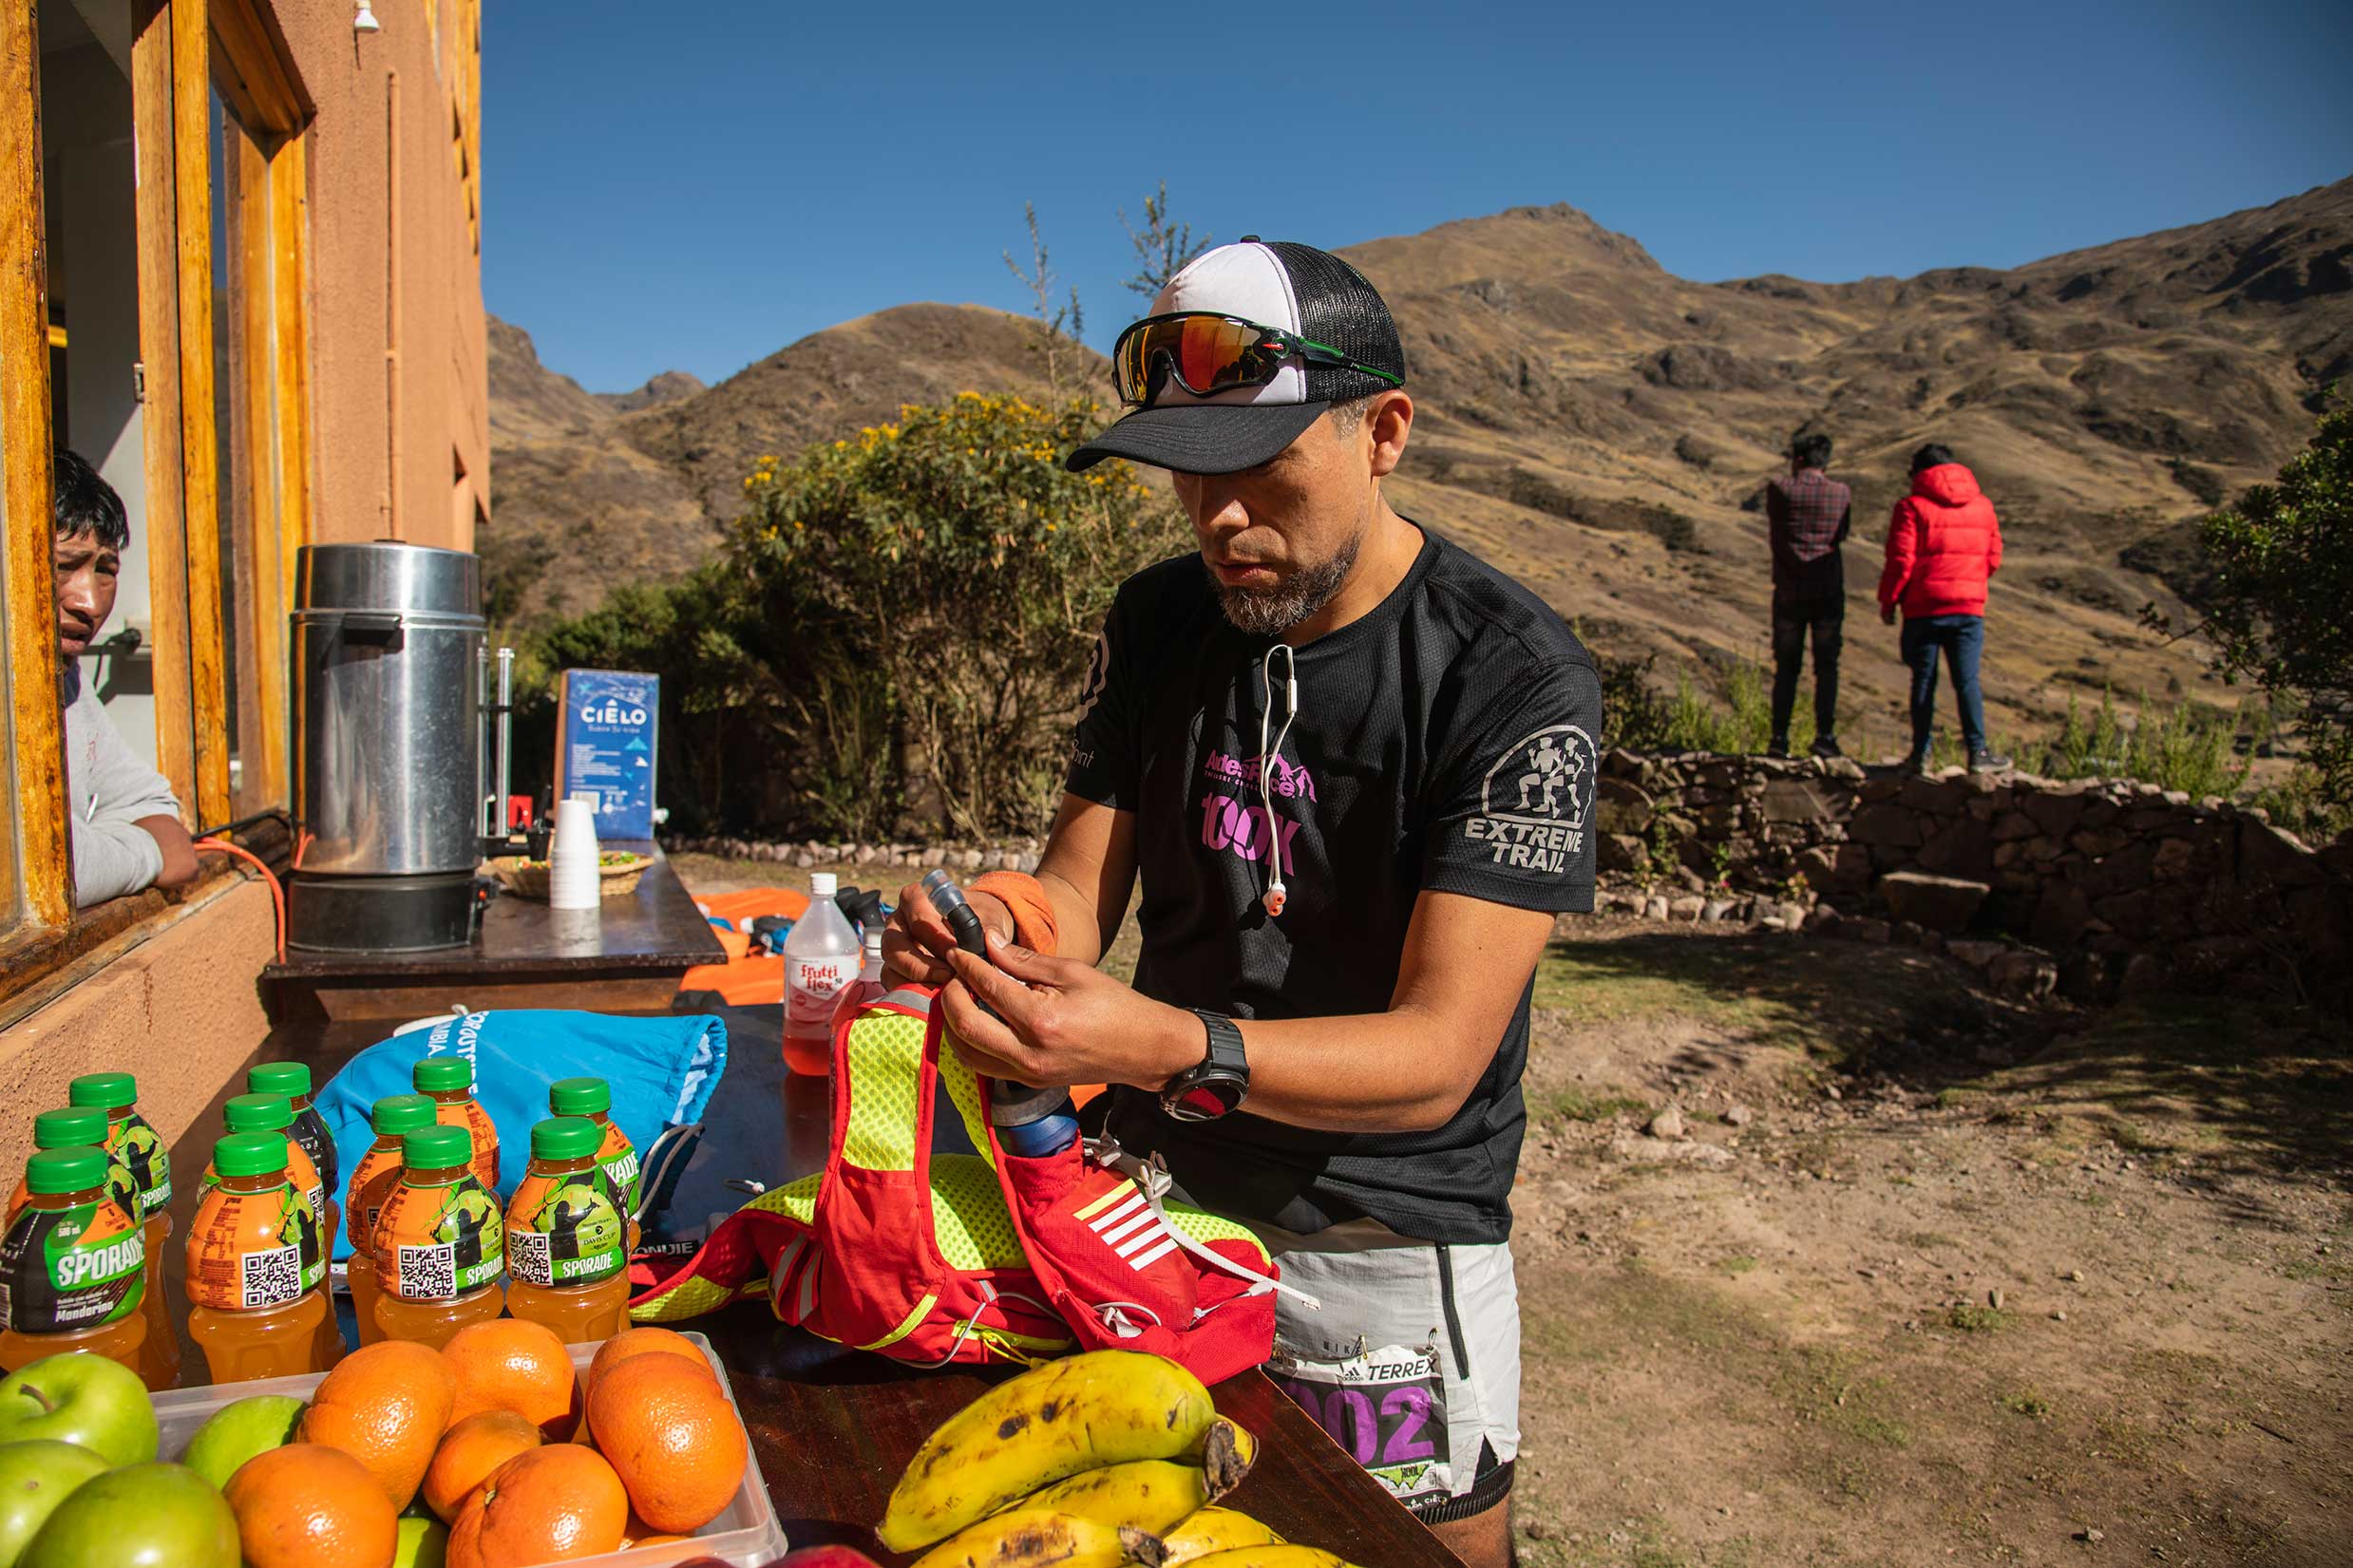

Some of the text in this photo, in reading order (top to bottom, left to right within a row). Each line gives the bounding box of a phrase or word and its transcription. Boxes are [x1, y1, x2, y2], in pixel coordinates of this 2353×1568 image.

[1201, 791, 1302, 877] 100K
[1464, 817, 1584, 853] EXTREME
[1490, 841, 1566, 874] TRAIL
[800, 964, 838, 979] frutti
[602, 1150, 639, 1185] RADE
[634, 1241, 694, 1255] ONIJIE
[466, 1253, 503, 1285] SPORAD
[561, 1251, 614, 1277] SPORADE
[1323, 1340, 1362, 1355] NIKE
[1367, 1358, 1437, 1381] TERREX
